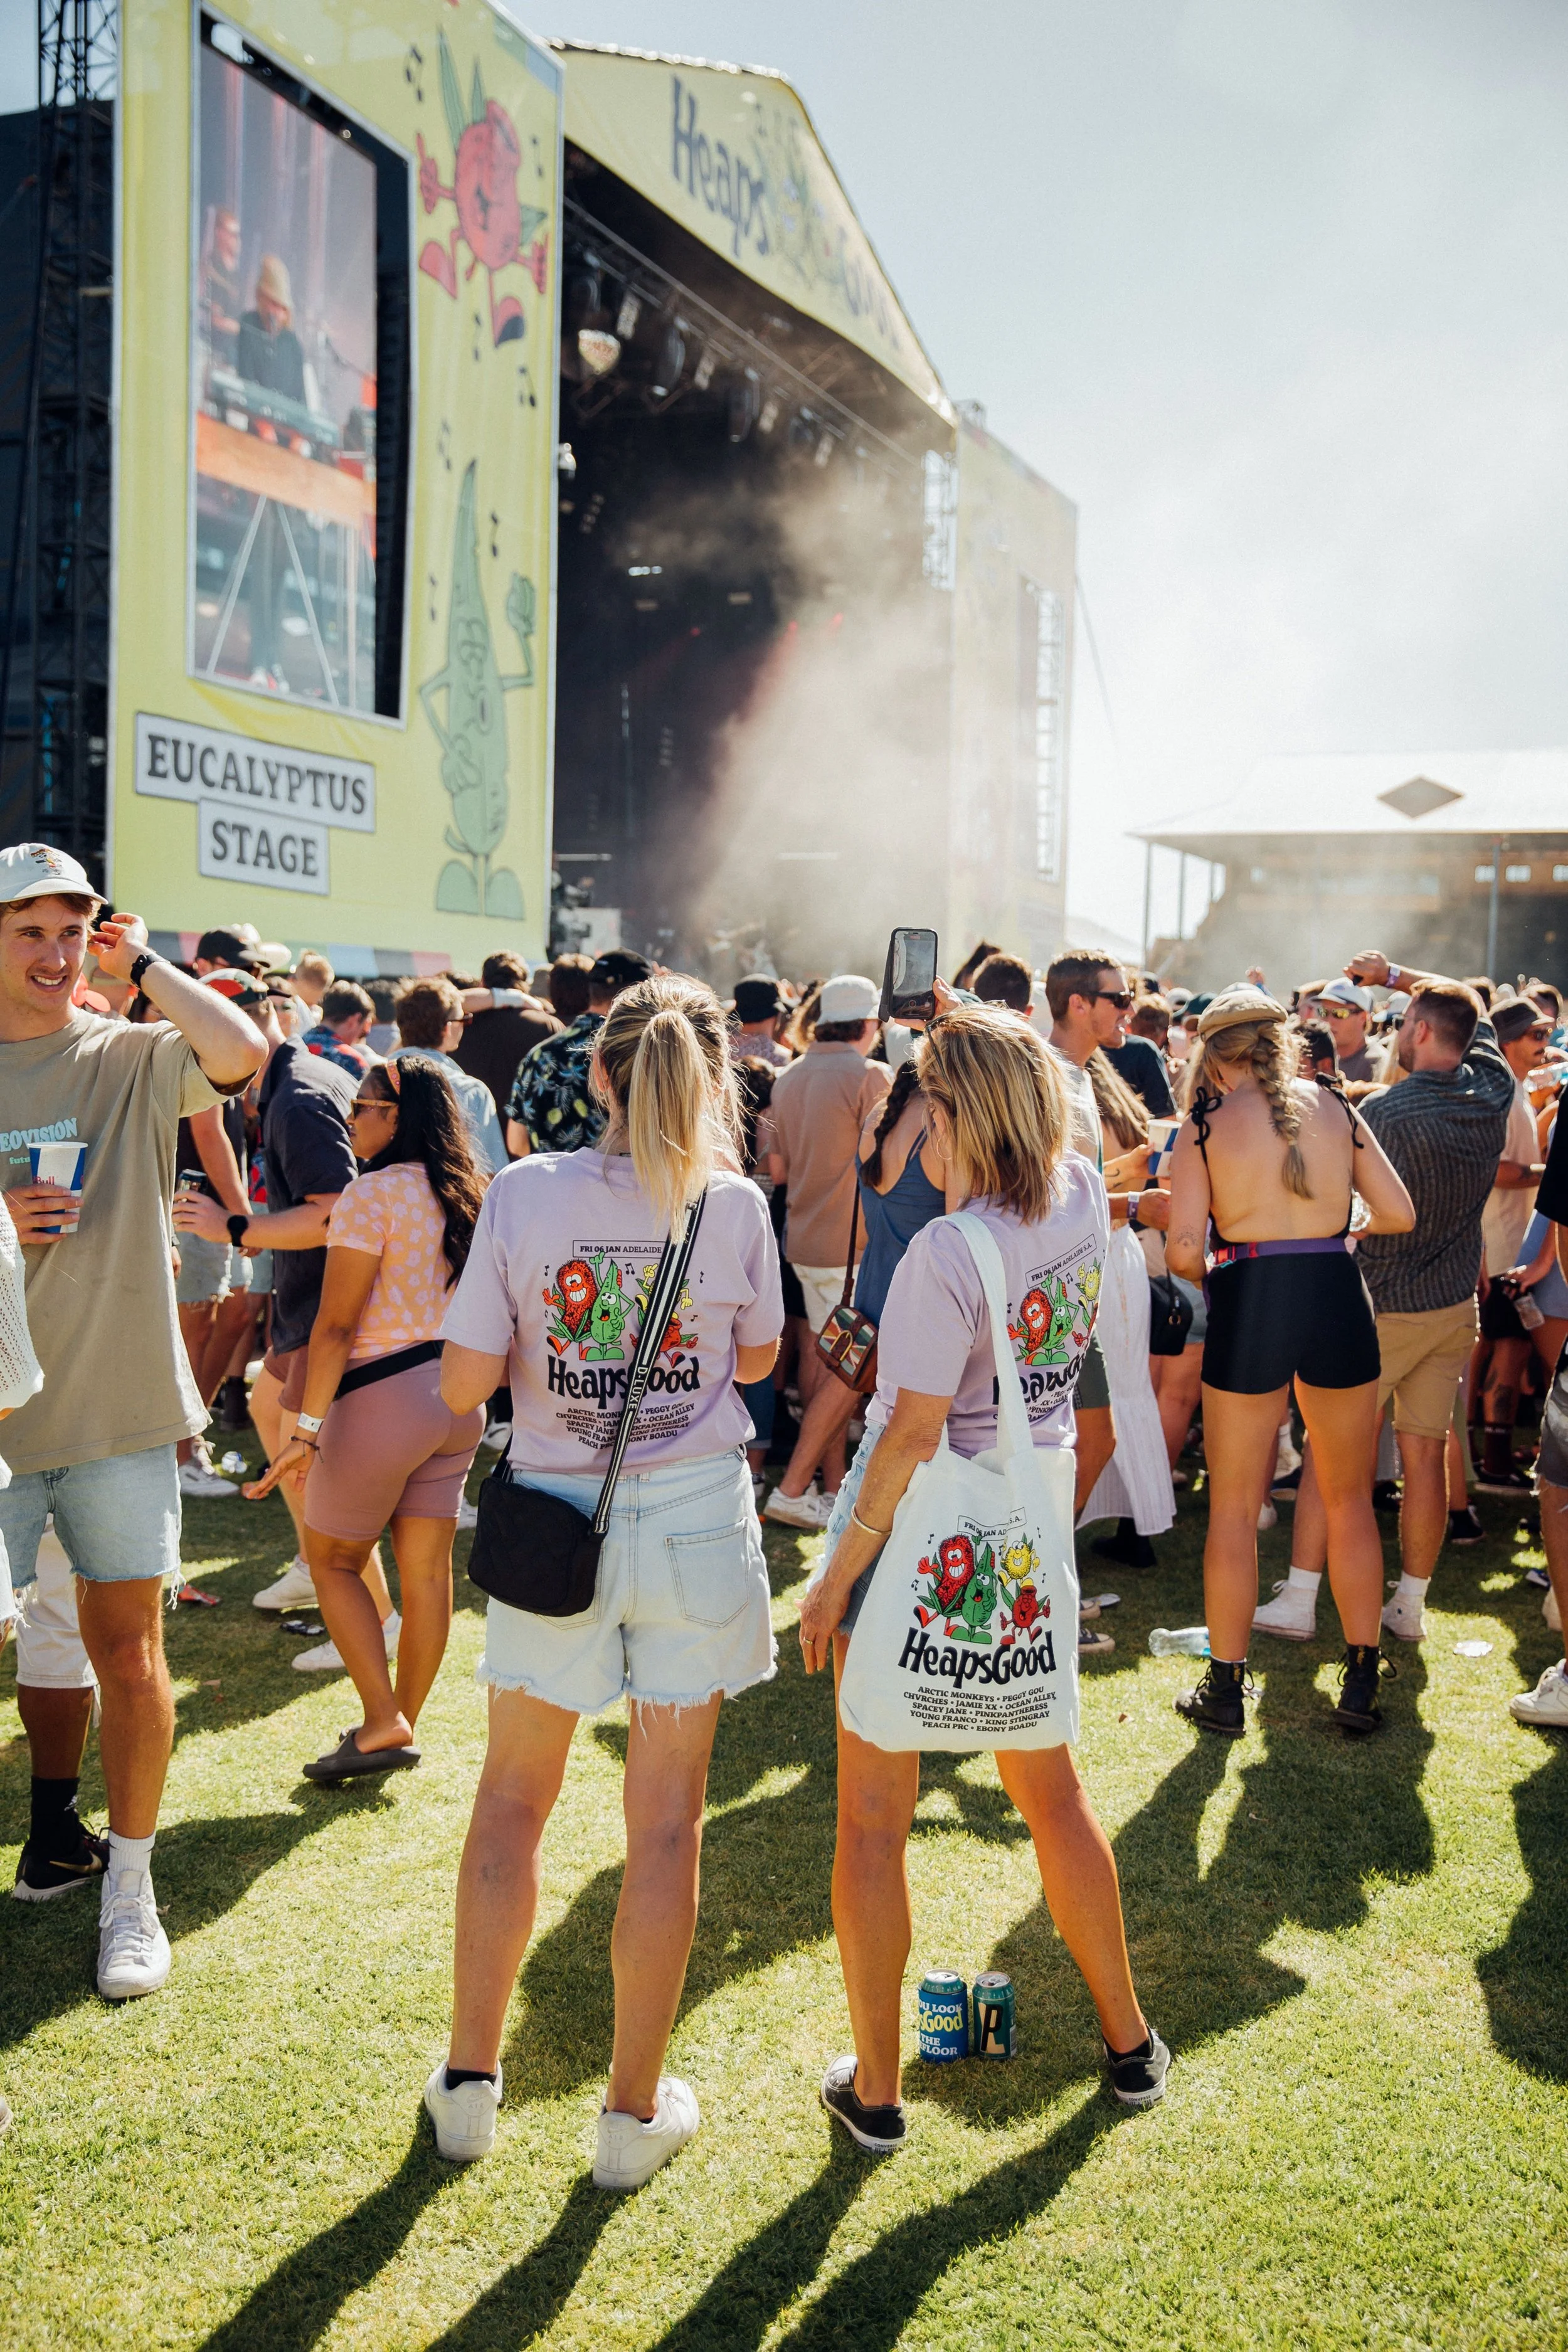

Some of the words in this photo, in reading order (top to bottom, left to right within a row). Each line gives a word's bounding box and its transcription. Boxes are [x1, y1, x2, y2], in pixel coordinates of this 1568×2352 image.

[672, 73, 771, 258] Heaps
[147, 734, 367, 815] EUCALYPTUS
[212, 820, 319, 877] STAGE
[604, 1246, 621, 1254] JAN
[1030, 1271, 1043, 1281] FRI
[1044, 1268, 1052, 1276] 06
[1051, 1261, 1062, 1274] JAN
[1062, 1247, 1084, 1267] ADELAIDE
[548, 1354, 701, 1410] Heapsood
[567, 1407, 595, 1417] ARCTIC
[645, 1405, 670, 1415] PEGGY
[649, 1411, 674, 1422] OCEAN
[675, 1402, 695, 1416] ALLEY
[556, 1412, 597, 1424] CHVRCHES
[566, 1419, 595, 1431] SPACEY
[595, 1425, 615, 1435] JANE
[566, 1426, 592, 1438] YOUNG
[650, 1421, 691, 1433] STINGRAY
[578, 1435, 598, 1449] PEACH
[649, 1429, 678, 1441] BOADU
[963, 1522, 976, 1532] FRI
[975, 1527, 982, 1535] 06
[983, 1529, 996, 1538] JAN
[898, 1626, 1057, 1689] HeapsGood
[903, 1691, 949, 1705] CHVRCHES
[955, 1700, 983, 1709] JAMIE
[1005, 1698, 1032, 1710] OCEAN
[1032, 1692, 1056, 1703] ALLEY
[918, 1686, 949, 1697] ARCTIC
[950, 1691, 995, 1702] MONKEYS
[1002, 1690, 1027, 1702] PEGGY
[1028, 1686, 1044, 1696] GOU
[910, 1710, 940, 1720] YOUNG
[942, 1715, 978, 1724] FRANCO
[1009, 1710, 1050, 1724] STINGRAY
[912, 1702, 945, 1713] SPACEY
[975, 1702, 1048, 1718] PINKPANTHERESS
[1008, 1721, 1037, 1731] BOADU
[919, 1999, 930, 2011] OU
[932, 2003, 963, 2013] LOOK
[920, 2033, 941, 2047] THE
